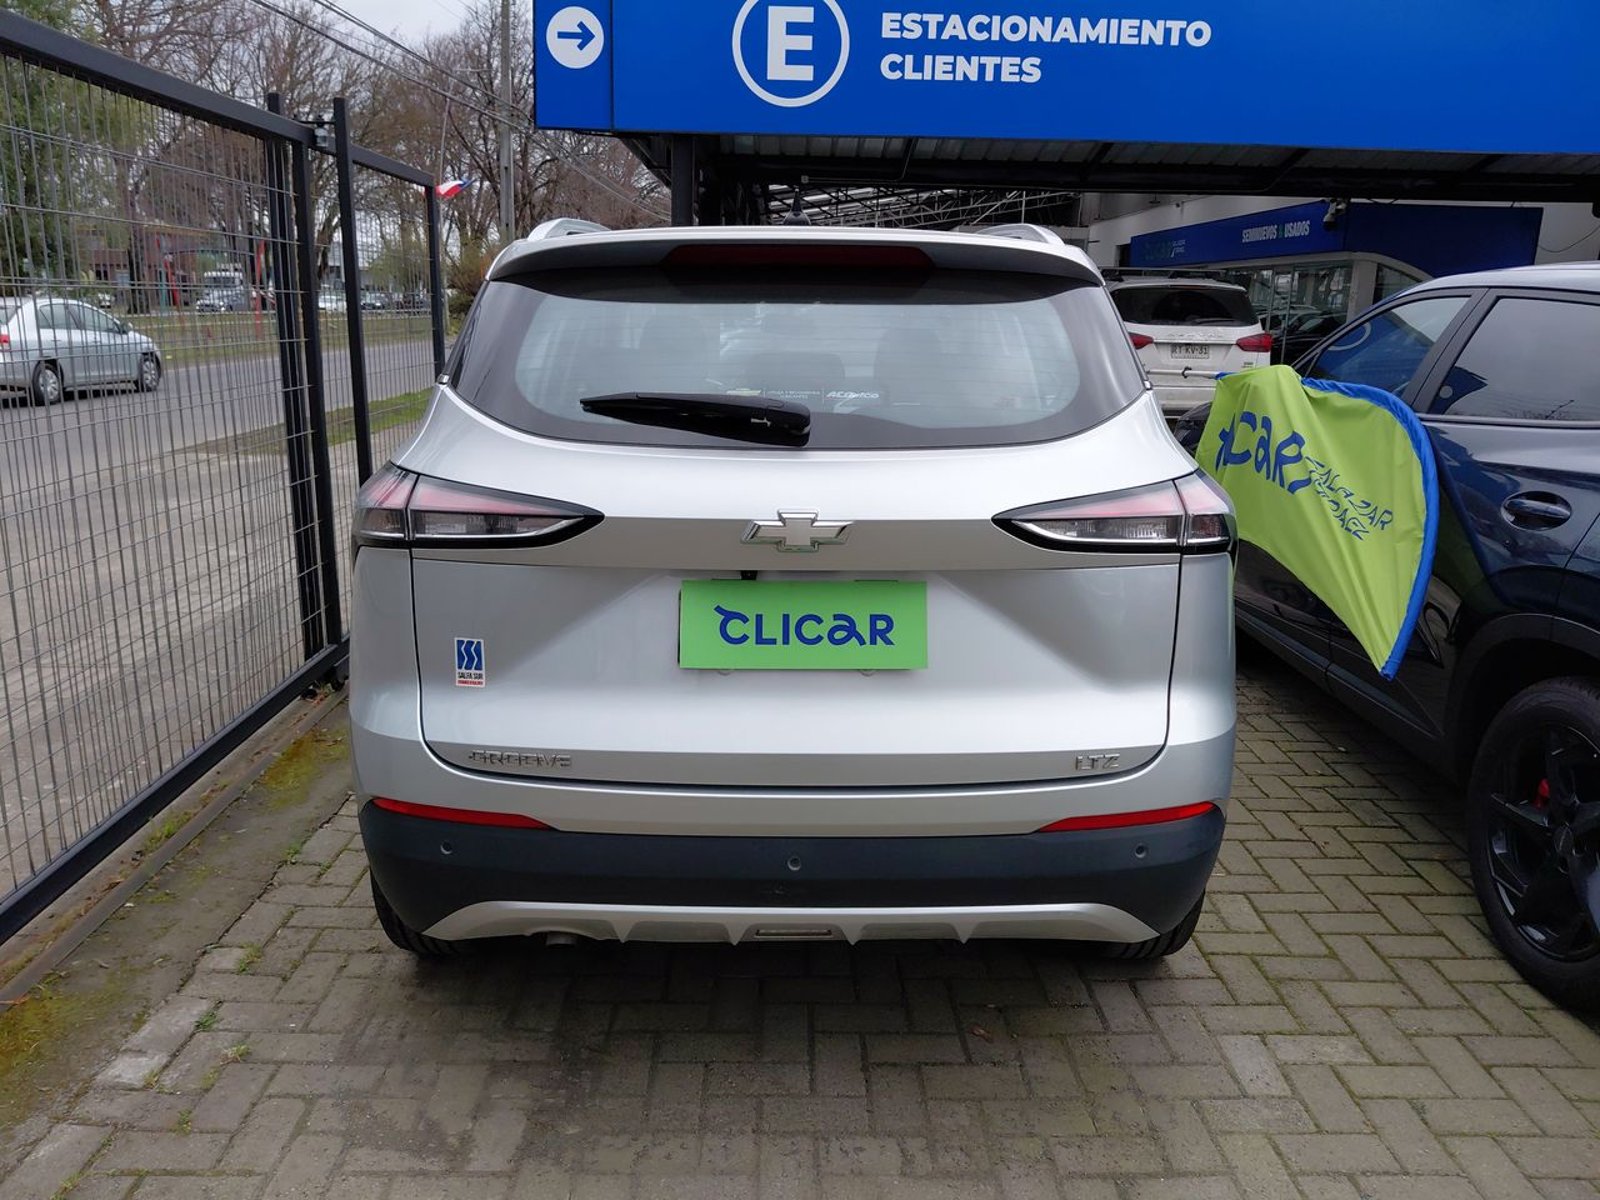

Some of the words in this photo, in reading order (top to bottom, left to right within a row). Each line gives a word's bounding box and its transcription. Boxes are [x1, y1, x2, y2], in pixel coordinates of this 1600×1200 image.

[767, 5, 815, 81] E
[882, 13, 1211, 46] ESTACIONAMIENTO
[881, 54, 1041, 82] CLIENTES
[1284, 220, 1311, 238] USADOS
[1075, 754, 1120, 770] LTZ
